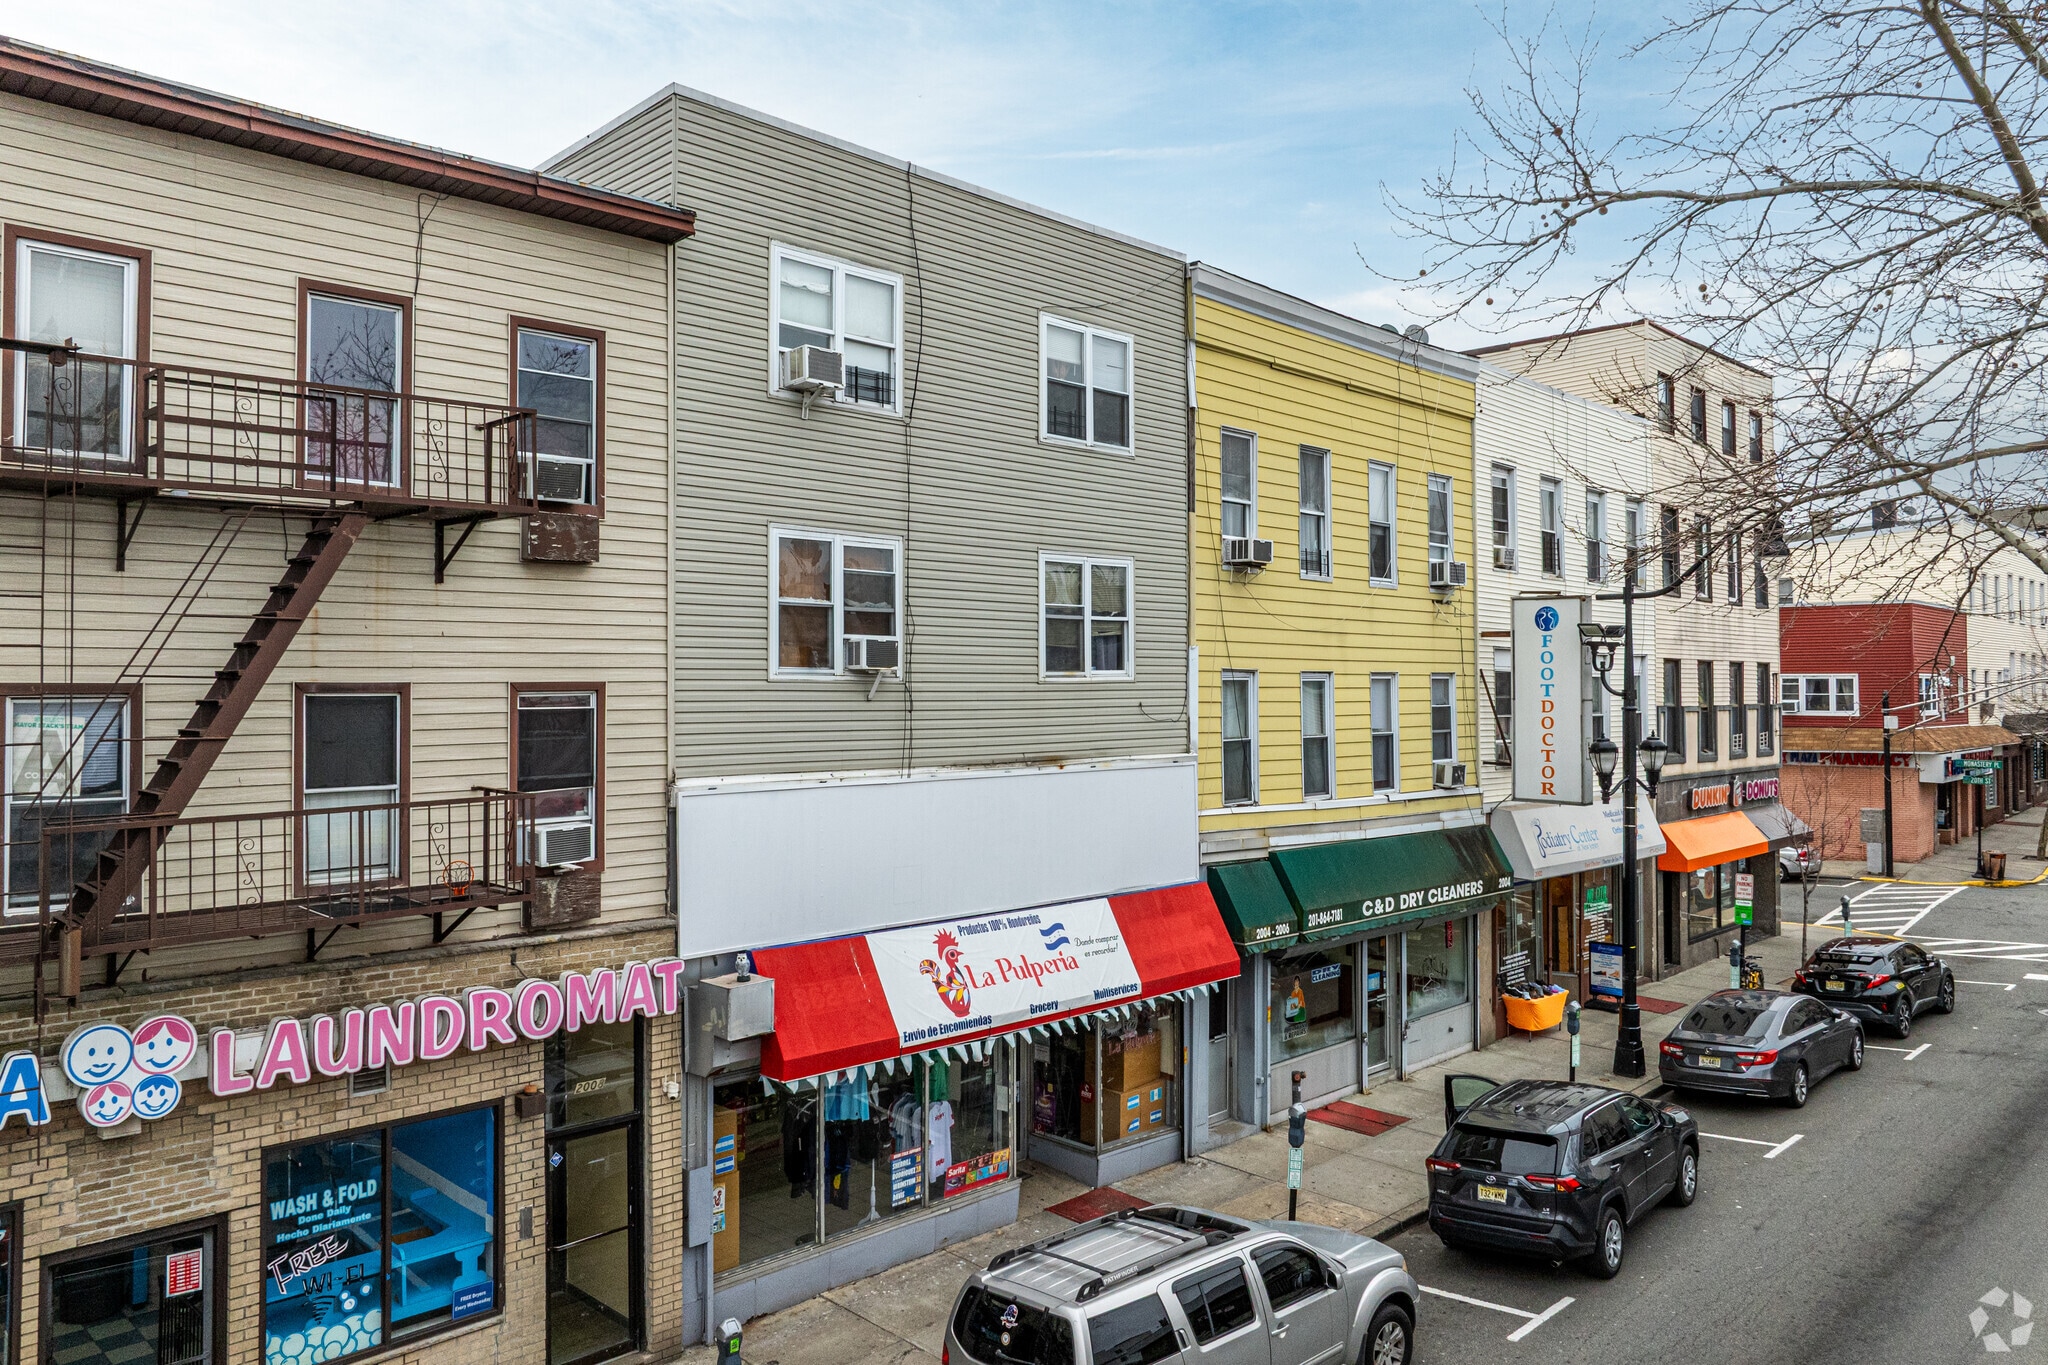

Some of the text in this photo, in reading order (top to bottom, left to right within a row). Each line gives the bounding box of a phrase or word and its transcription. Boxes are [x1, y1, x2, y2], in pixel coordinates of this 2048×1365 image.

[1540, 634, 1557, 796] FOOT DOCTOR
[1963, 760, 1993, 768] MONASTERY
[1746, 778, 1779, 801] DONUTS
[1970, 776, 1984, 784] 20TH
[1569, 824, 1600, 844] Center
[1498, 876, 1511, 889] 2004
[1362, 880, 1484, 916] C&D DRY CLEANERS
[957, 922, 988, 937] Productos
[988, 919, 1007, 931] 100%
[1256, 927, 1271, 940] 2004
[1275, 923, 1290, 936] 2006
[1095, 934, 1119, 945] comprar
[964, 964, 996, 989] La
[1312, 964, 1340, 976] DRY
[1312, 970, 1340, 983] CLEANING
[1093, 982, 1138, 1000] Multiservices
[1029, 1000, 1059, 1015] Grocery
[211, 958, 685, 1097] LAUNDROMAT
[903, 1015, 993, 1043] Envio de Encomiendas
[270, 1179, 377, 1221] WASH & FOLD
[298, 1205, 352, 1225] Done Daily
[276, 1212, 372, 1244] Hecho Diariamente
[267, 1234, 349, 1295] FREE
[1103, 1265, 1139, 1286] PATHFINDER
[460, 1294, 472, 1302] FREE
